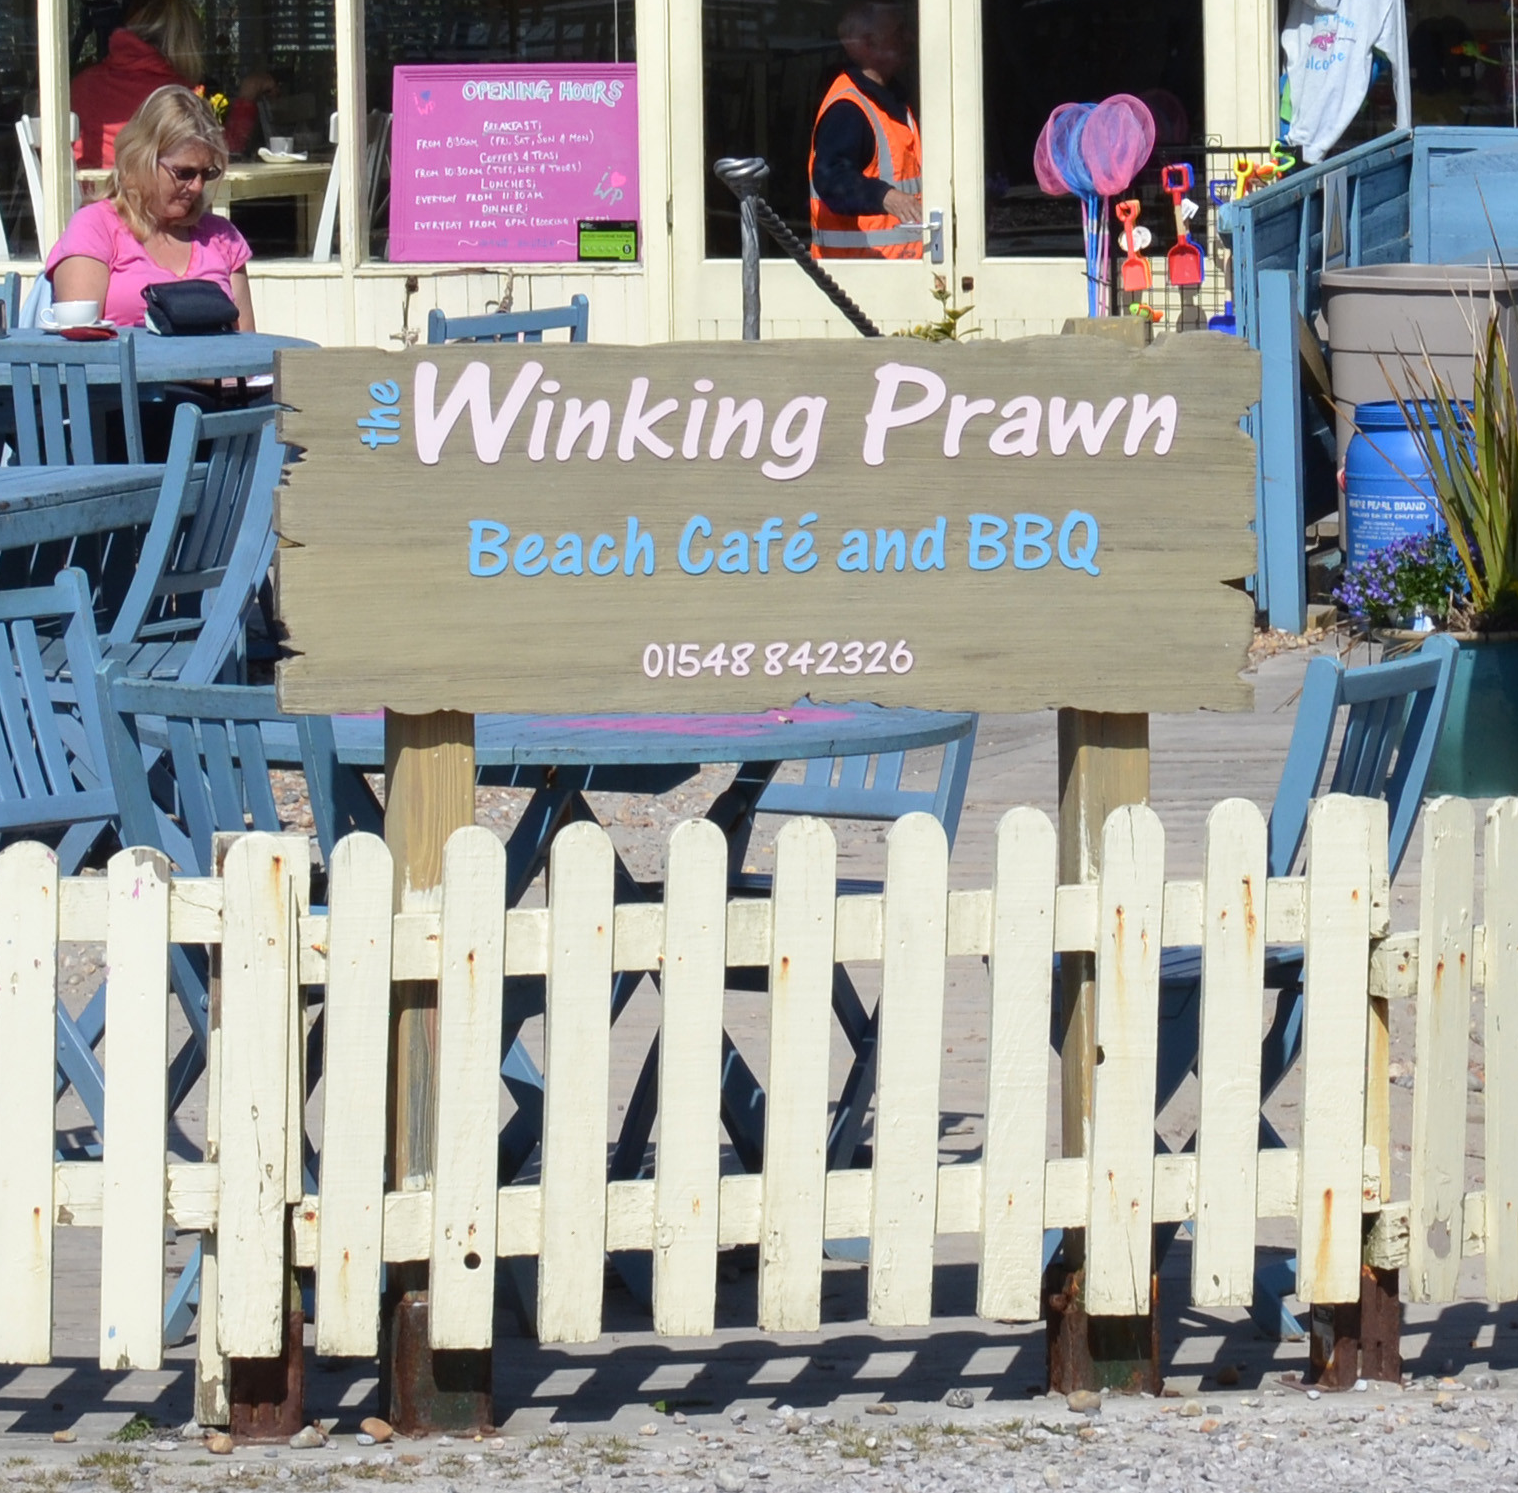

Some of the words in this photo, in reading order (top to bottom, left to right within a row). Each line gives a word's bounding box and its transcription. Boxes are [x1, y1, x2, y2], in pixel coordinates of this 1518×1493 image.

[462, 80, 554, 103] OPENING
[559, 79, 625, 108] HOURS
[416, 139, 441, 150] FROM
[537, 133, 555, 144] SUN
[569, 129, 594, 145] MON)
[415, 168, 439, 178] FROM
[415, 194, 457, 205] EVERYDAY
[466, 193, 493, 203] FROM
[414, 221, 462, 231] EVERYDAY
[469, 220, 497, 229] FROM
[505, 218, 528, 228] 6PM
[357, 378, 401, 450] the
[411, 361, 828, 481] Winking
[860, 361, 1178, 468] Prawn
[1394, 501, 1426, 511] BRAND
[467, 516, 656, 578] Beach
[677, 513, 819, 575] Café
[836, 512, 947, 573] and
[967, 510, 1101, 577] BBQ
[642, 641, 754, 679] 01548
[762, 639, 915, 677] 842326
